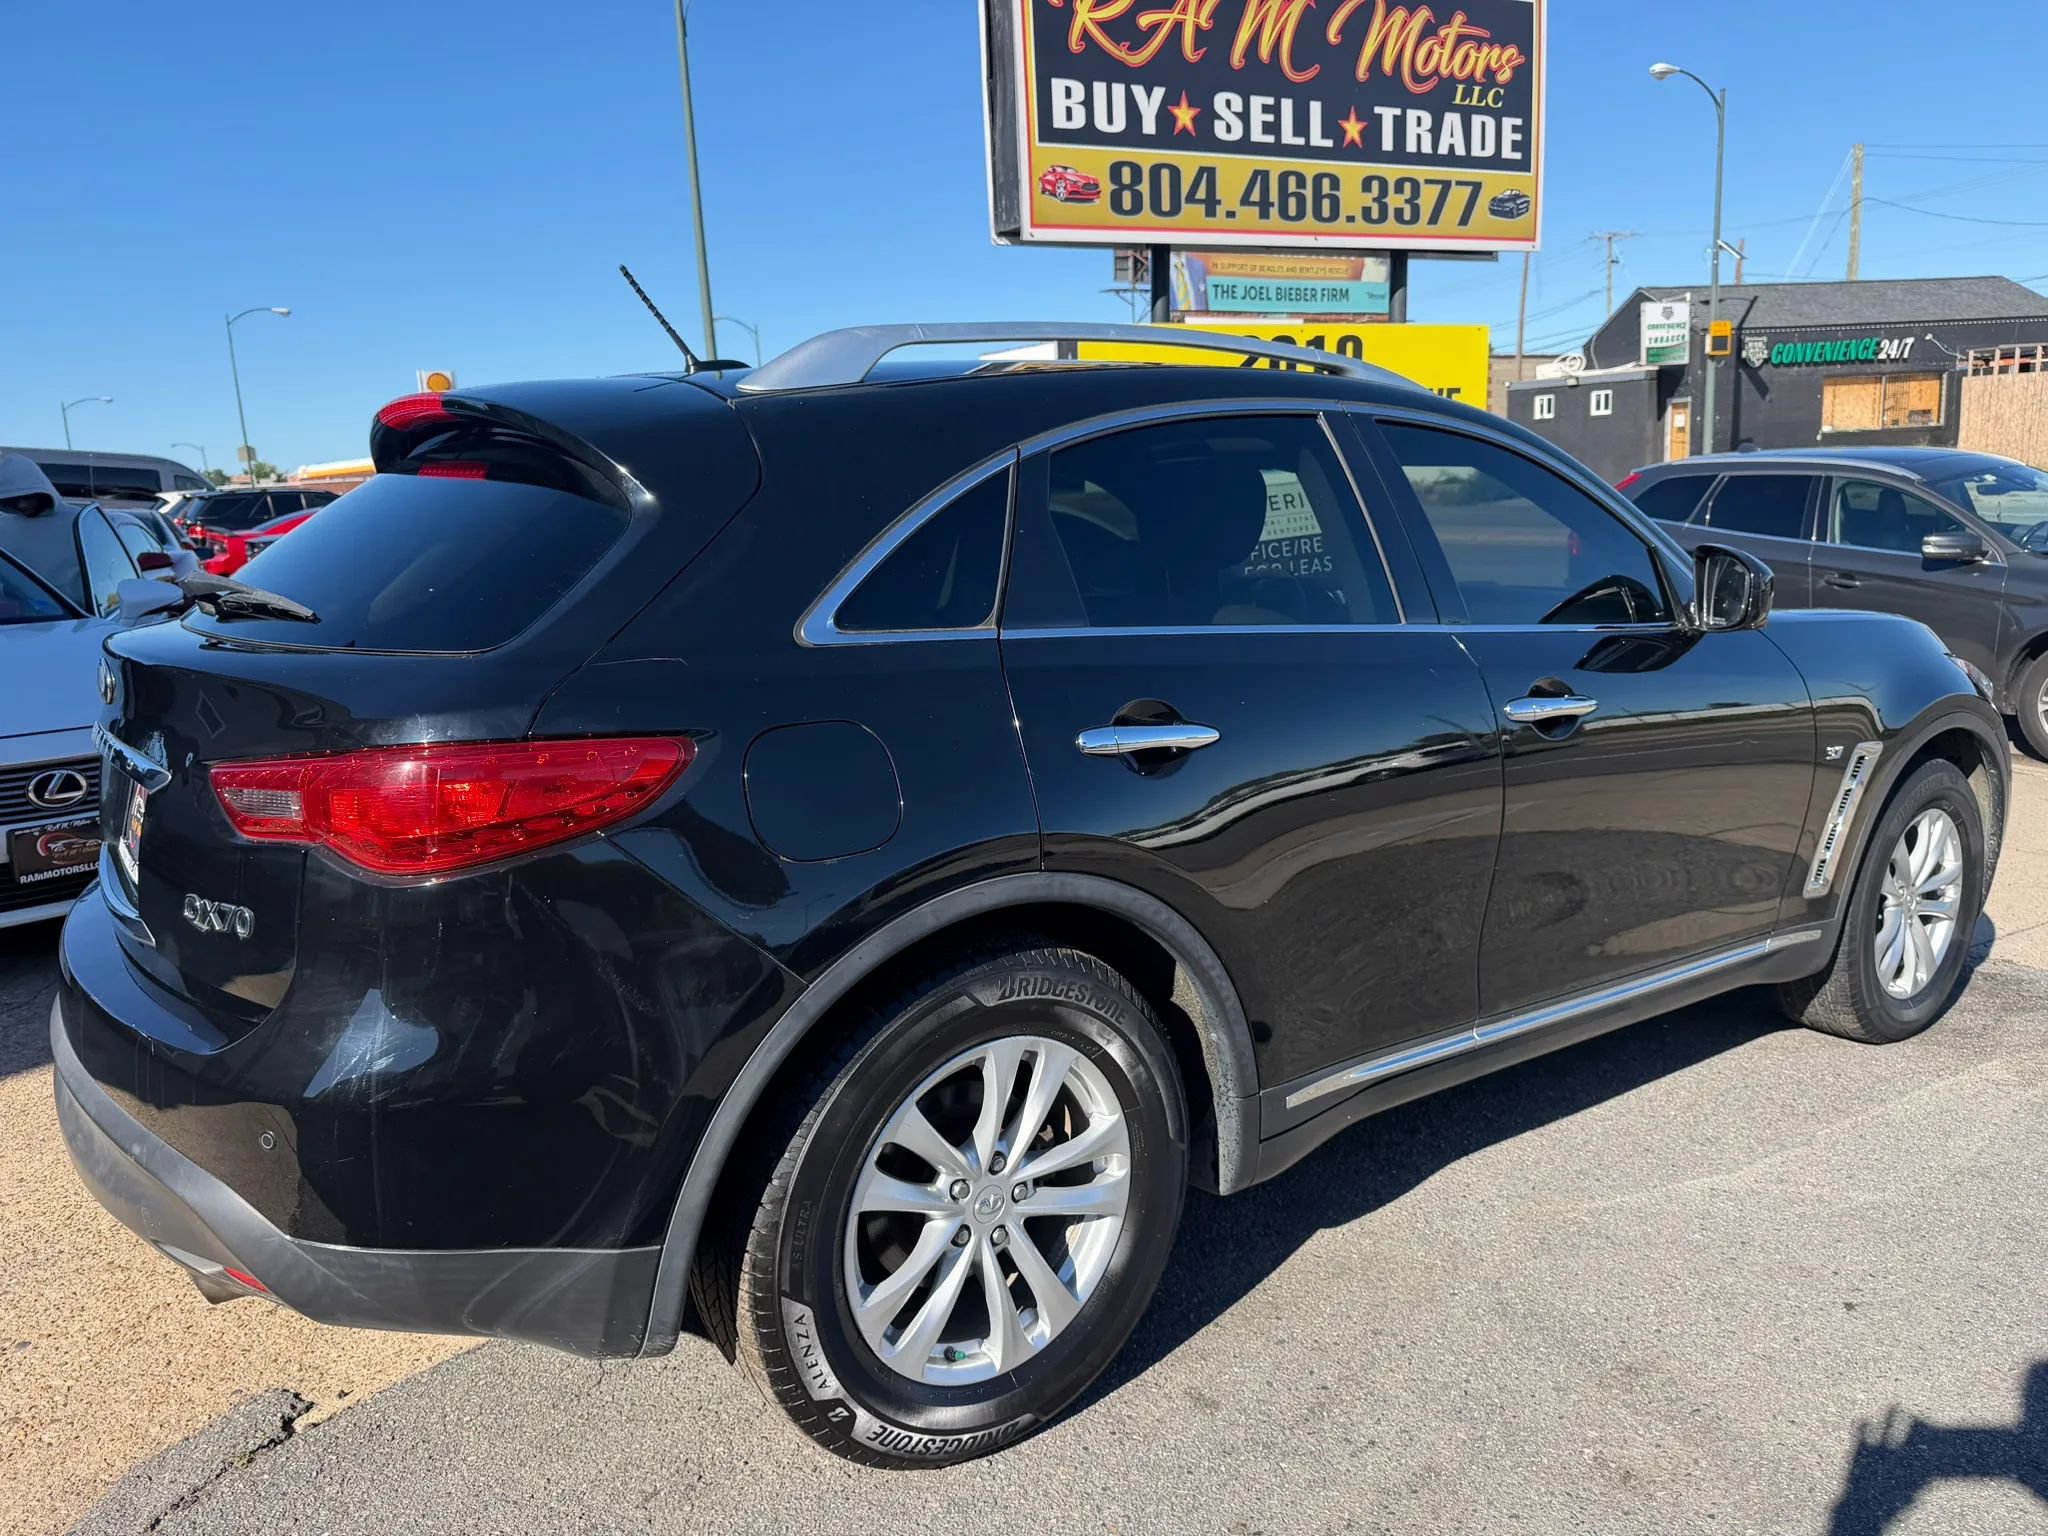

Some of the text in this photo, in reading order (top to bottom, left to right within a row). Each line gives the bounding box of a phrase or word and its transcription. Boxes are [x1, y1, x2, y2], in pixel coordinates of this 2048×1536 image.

[1327, 0, 1526, 94] Motors
[1452, 84, 1505, 108] LLC
[1051, 77, 1523, 160] BUY SELL TRADE
[1109, 160, 1482, 227] 804.466.3377
[1220, 263, 1249, 272] SUPPORT
[1212, 284, 1237, 299] THE
[1241, 285, 1272, 301] JOEL
[1275, 287, 1317, 302] BIEBER
[1321, 288, 1349, 303] FIRM
[1771, 337, 1881, 365] CONVENIENCE
[1877, 336, 1915, 360] 24/7
[1268, 493, 1304, 511] ERI
[184, 893, 255, 937] QX70
[998, 974, 1128, 1026] BRIDGESTONE
[794, 1314, 831, 1389] ALENZA
[866, 1420, 1020, 1456] BRIDGESTONE
